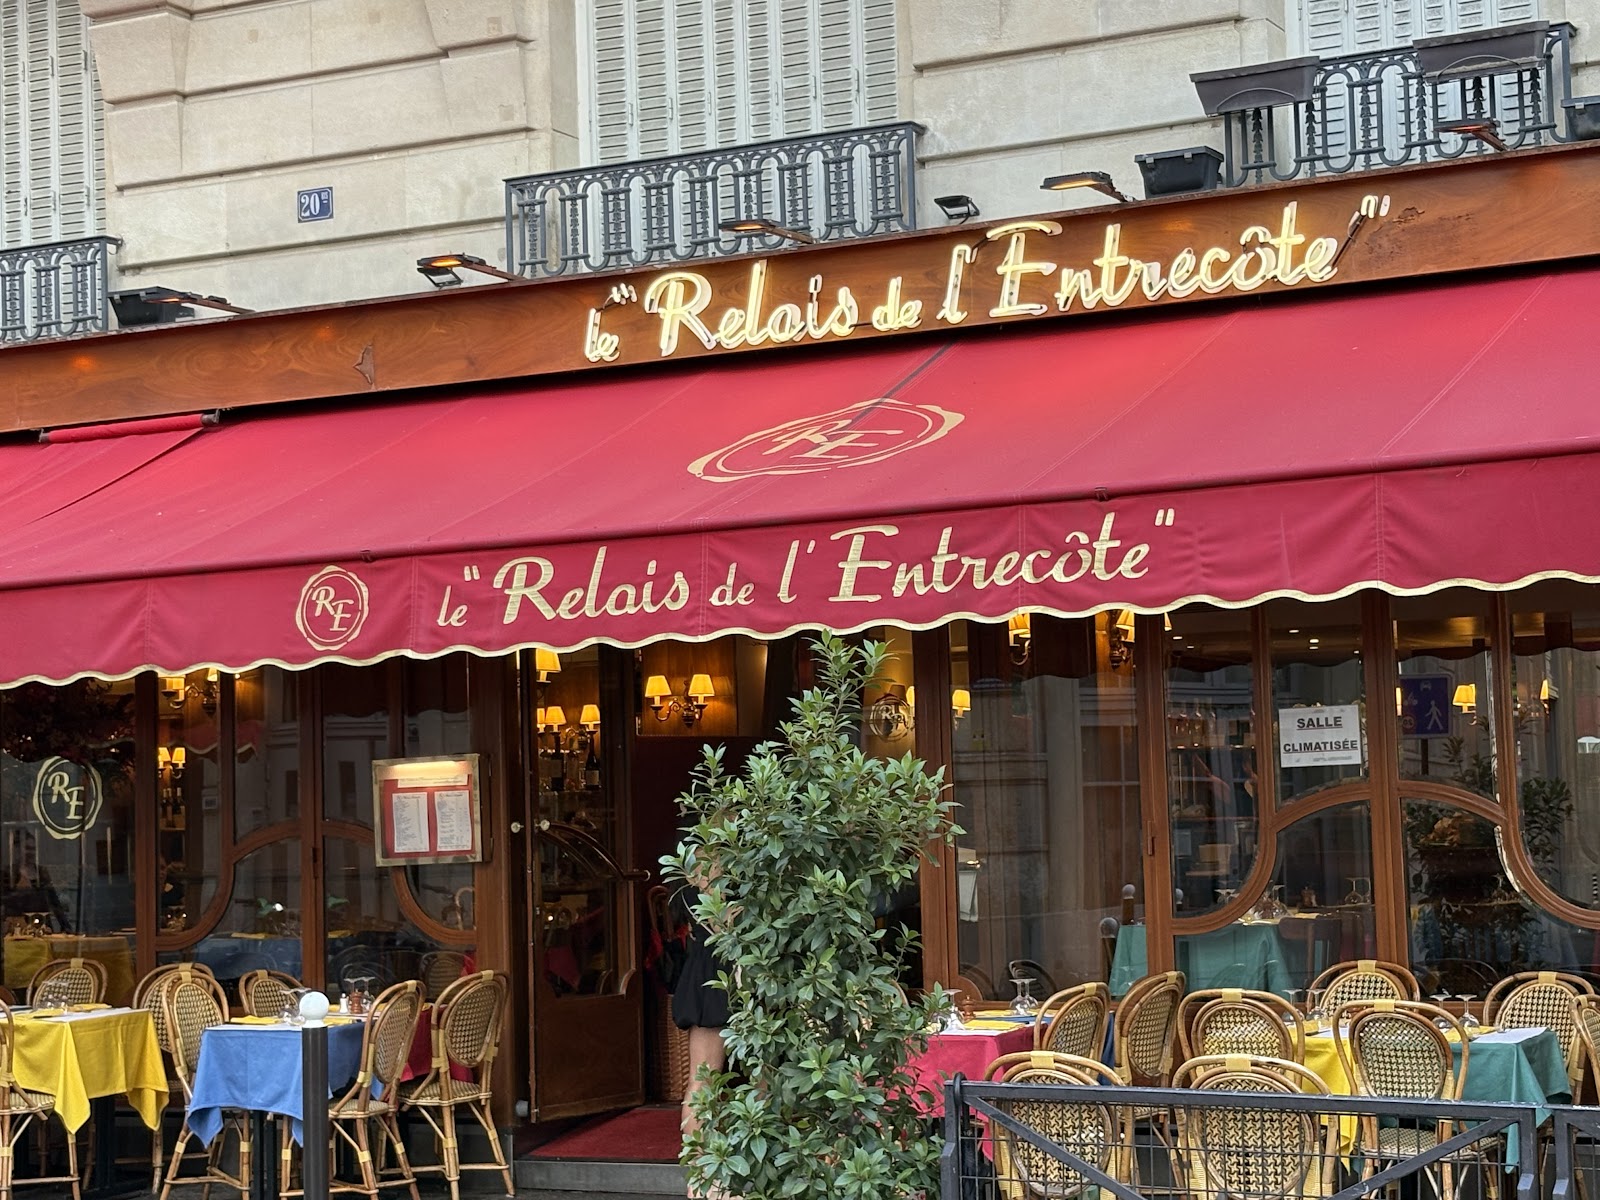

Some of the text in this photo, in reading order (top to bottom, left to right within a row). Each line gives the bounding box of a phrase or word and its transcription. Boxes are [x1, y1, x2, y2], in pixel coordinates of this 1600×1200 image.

[301, 193, 320, 217] 20
[584, 308, 620, 362] le
[872, 276, 923, 332] de
[762, 419, 904, 459] RE
[311, 585, 354, 633] RE
[436, 585, 468, 627] le
[709, 562, 755, 607] de
[1296, 716, 1343, 730] SALLE
[1283, 738, 1359, 753] CLIMATISÉE
[48, 771, 84, 820] RE
